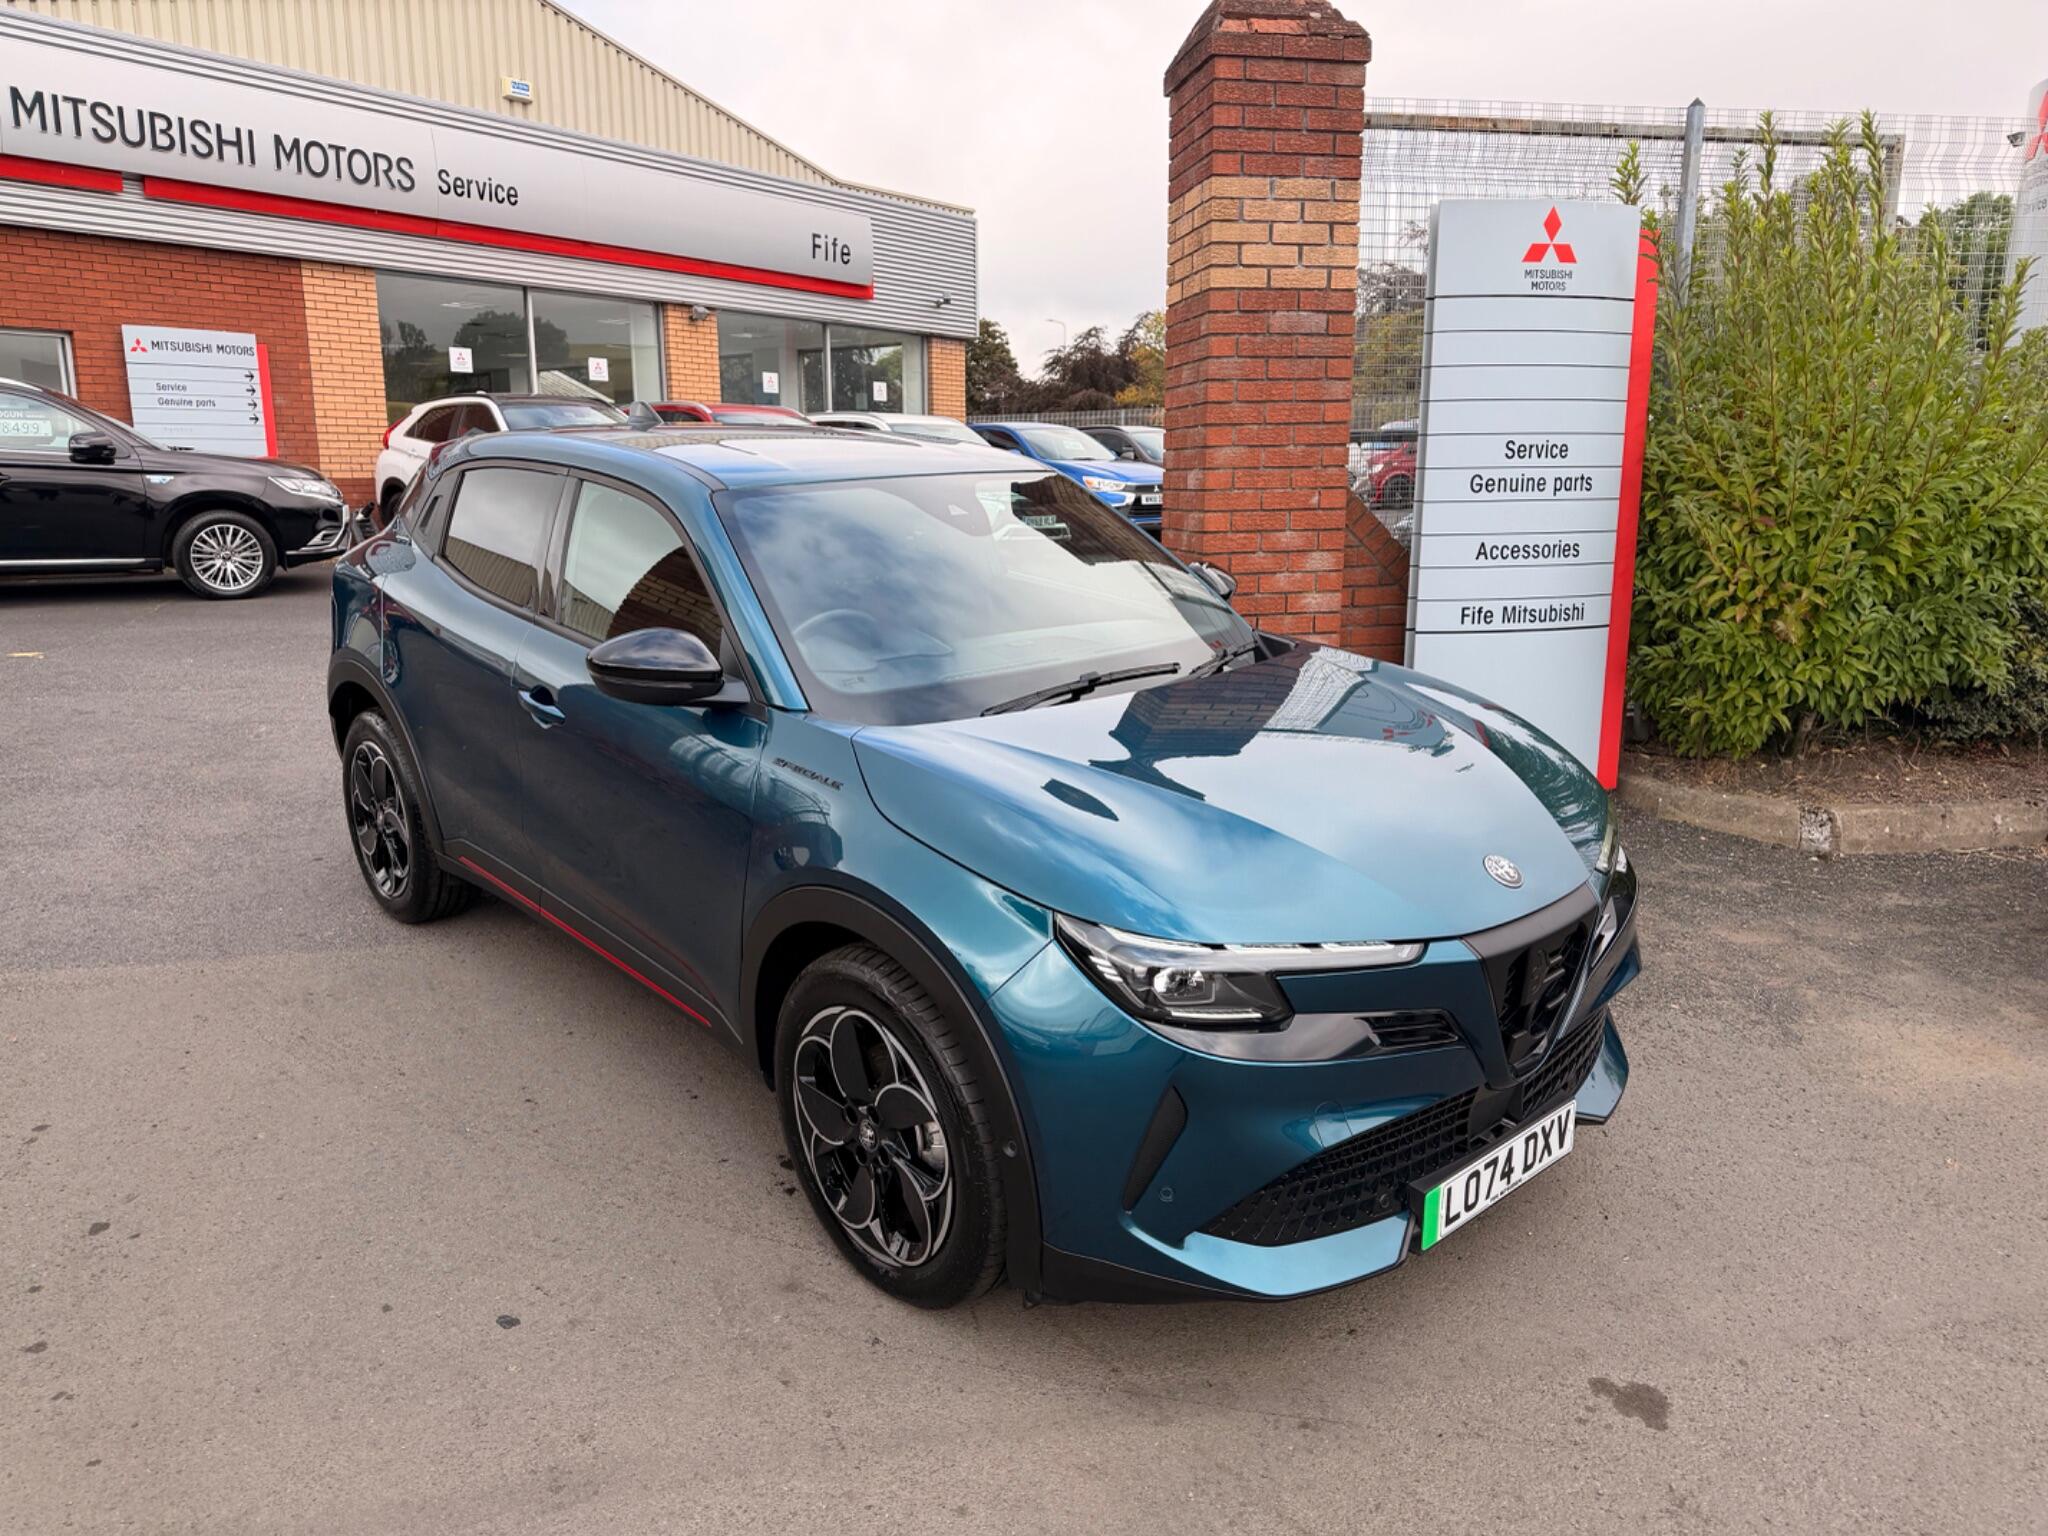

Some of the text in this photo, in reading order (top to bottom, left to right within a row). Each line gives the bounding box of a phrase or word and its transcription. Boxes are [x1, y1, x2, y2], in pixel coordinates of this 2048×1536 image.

[9, 86, 520, 207] MITSUBISHI MOTORS Service
[811, 233, 851, 265] Fife
[1524, 269, 1573, 280] MITSUBISHI
[1531, 281, 1567, 292] MOTORS
[151, 340, 255, 357] MITSUBISHI MOTORS
[155, 382, 187, 392] Service
[157, 397, 216, 408] Genuine parts
[1505, 440, 1569, 460] Service
[1469, 473, 1593, 497] Genuine parts
[1475, 540, 1580, 561] Accessories
[1460, 602, 1585, 626] Fife Mitsubishi
[1445, 1108, 1571, 1228] LO74 DXV
